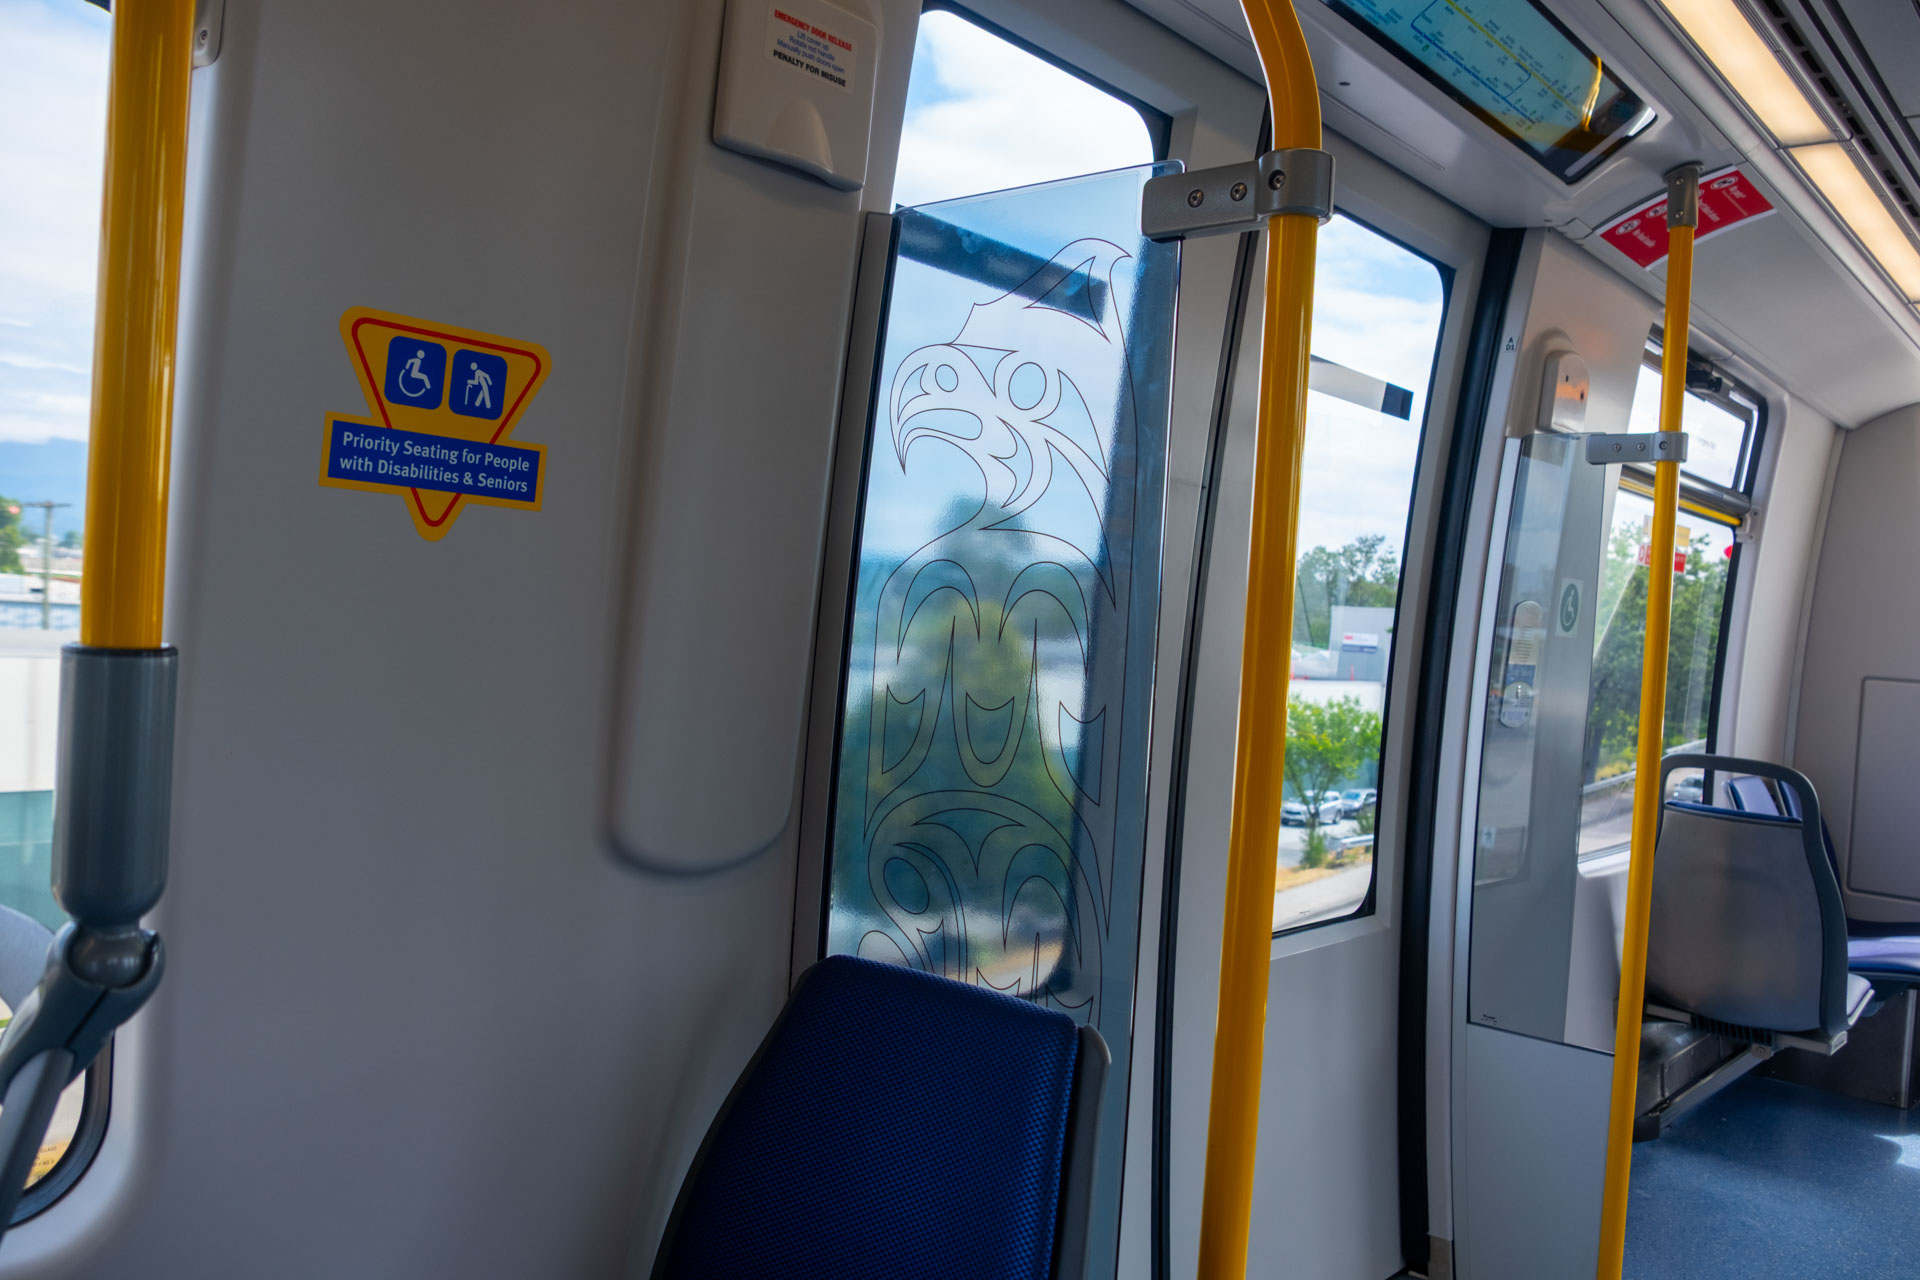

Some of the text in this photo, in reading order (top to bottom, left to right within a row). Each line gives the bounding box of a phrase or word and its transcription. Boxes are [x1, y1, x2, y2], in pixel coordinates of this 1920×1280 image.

[774, 9, 852, 52] EMERGENCY DOOR RELEASE
[773, 49, 846, 87] PENALTY FOR MISUSE
[343, 431, 530, 473] Priority Seating for People
[340, 456, 528, 493] with Disabilities & Seniors
